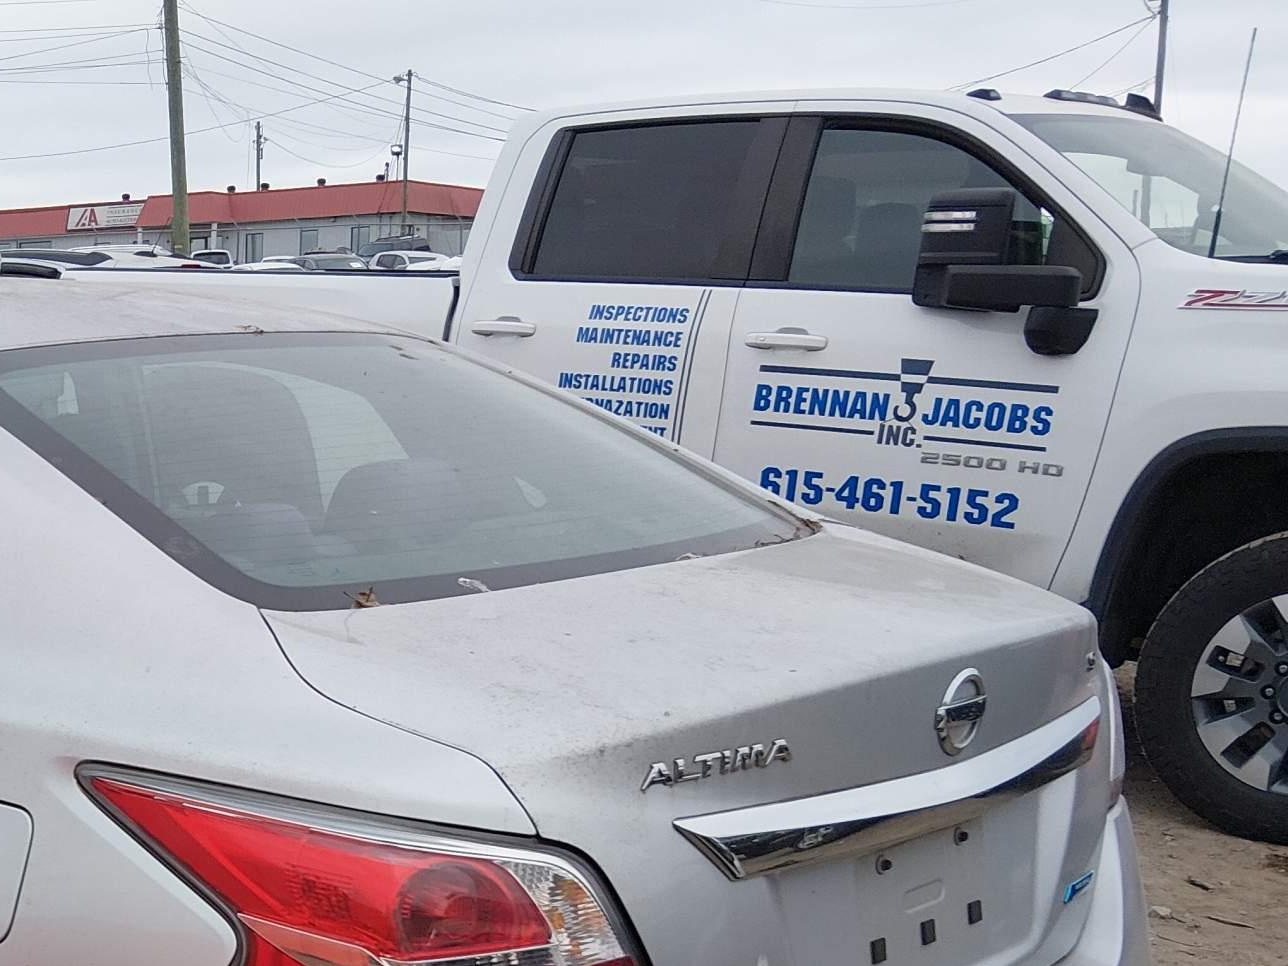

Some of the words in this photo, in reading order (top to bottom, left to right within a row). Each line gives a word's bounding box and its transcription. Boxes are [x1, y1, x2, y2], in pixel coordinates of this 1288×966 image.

[589, 304, 689, 323] INSPECTIONS
[576, 326, 683, 348] MAINTENANCE
[611, 351, 678, 371] REPAIRS
[558, 372, 674, 396] INSTALLATIONS
[753, 384, 890, 421] BRENNAN
[922, 397, 1054, 436] JACOBS
[877, 423, 922, 448] INC.
[921, 452, 1006, 471] 2500
[1018, 460, 1064, 477] HD
[760, 466, 1019, 529] 615-461-5152
[640, 738, 791, 792] ALTIMA
